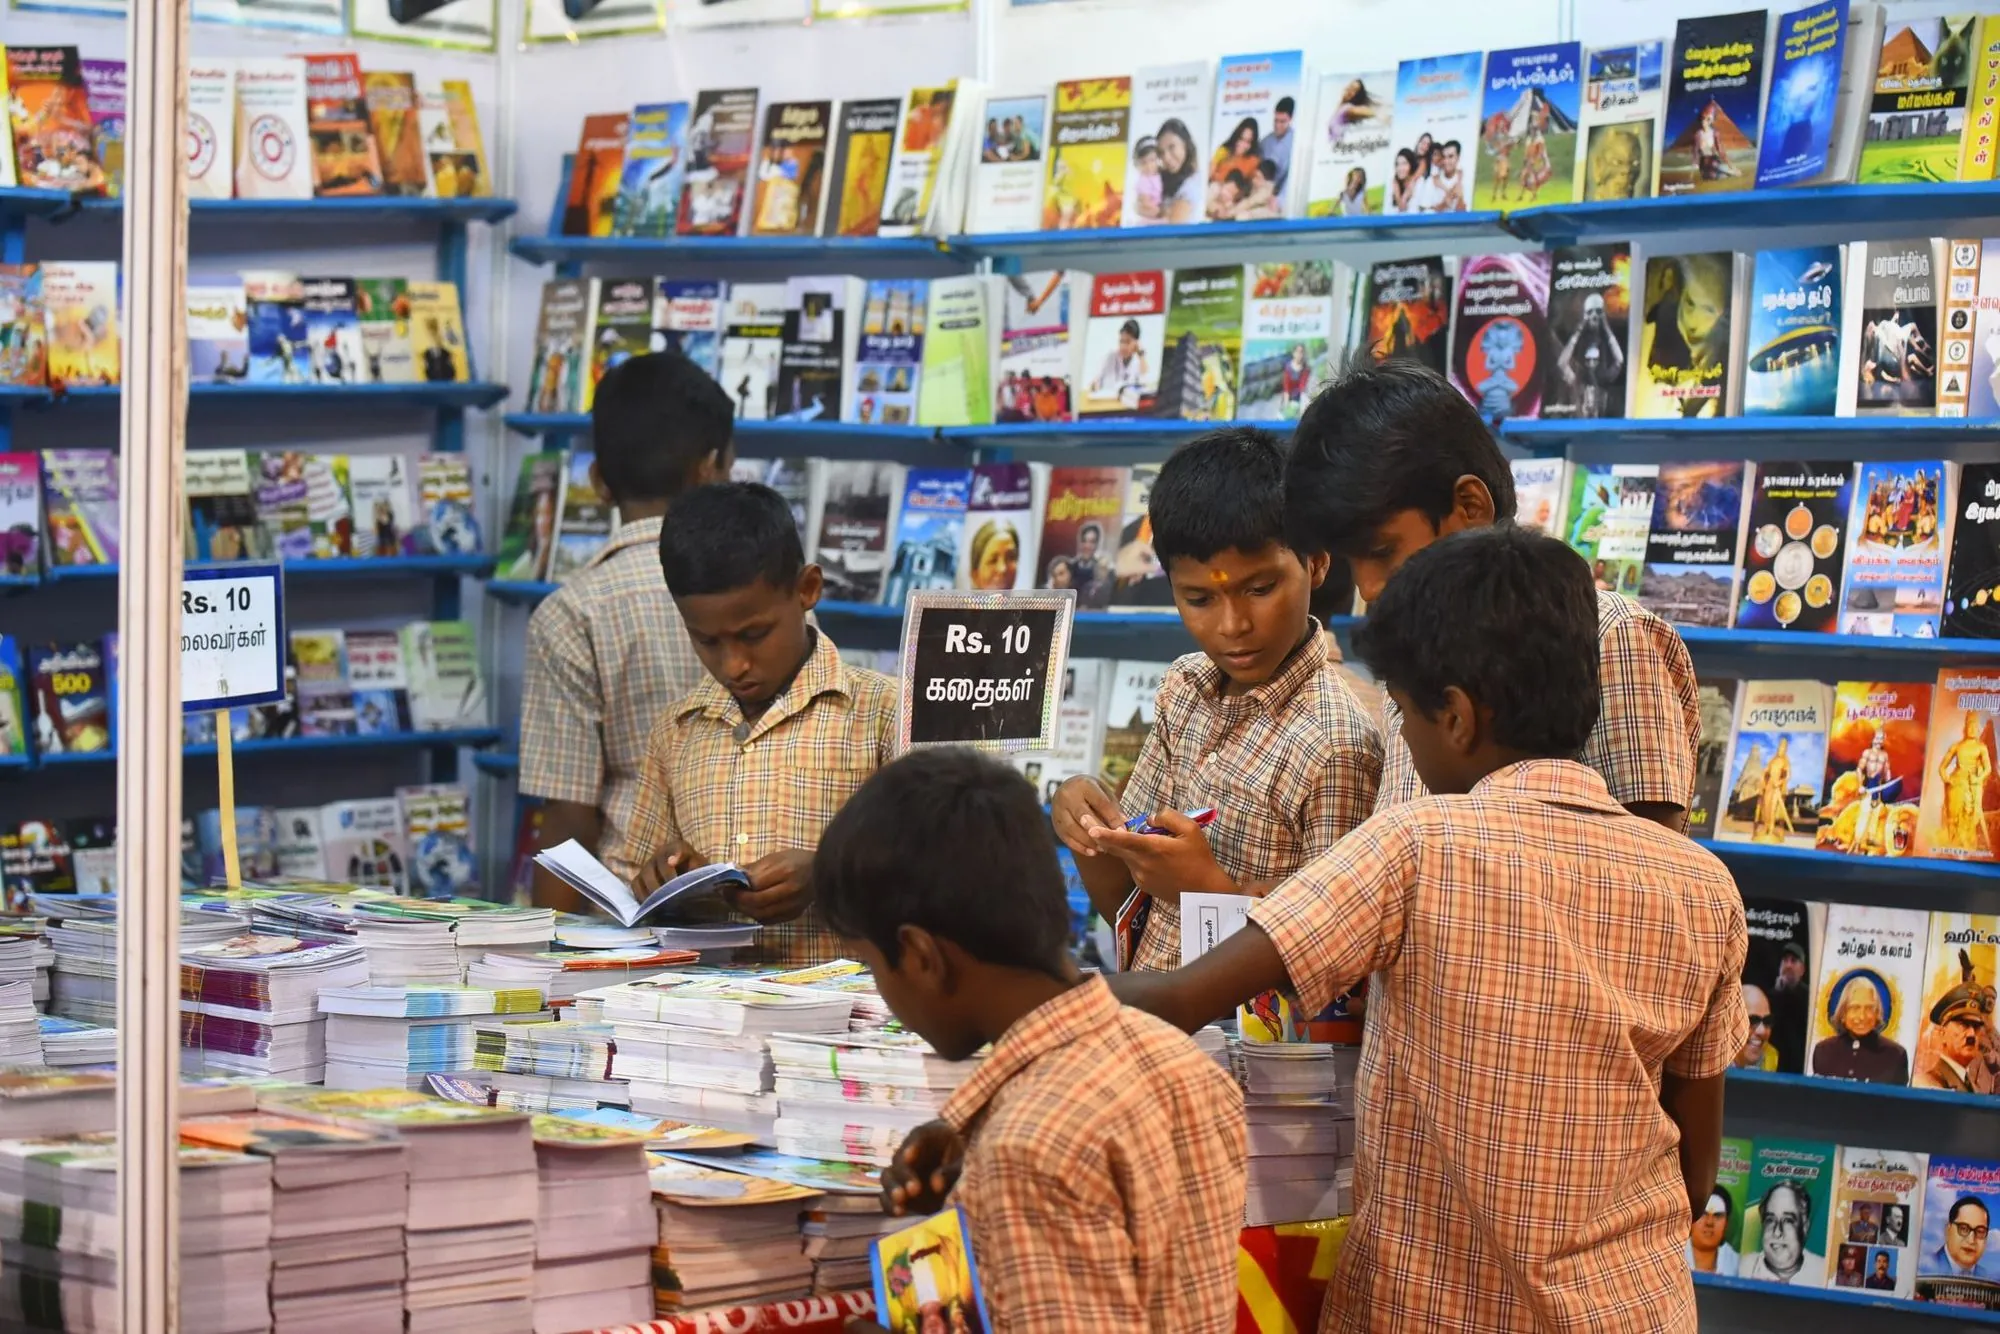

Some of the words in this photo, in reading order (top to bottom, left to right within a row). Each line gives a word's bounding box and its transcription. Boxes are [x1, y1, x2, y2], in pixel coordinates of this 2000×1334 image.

[225, 587, 251, 611] 10
[181, 622, 267, 652] லைவர்கள்
[945, 624, 991, 654] Rs.
[1002, 625, 1030, 654] 10
[52, 673, 91, 694] 500
[926, 668, 1034, 710] கதைகள்
[1837, 939, 1876, 958] அப்துல்
[1880, 942, 1913, 959] கலாம்
